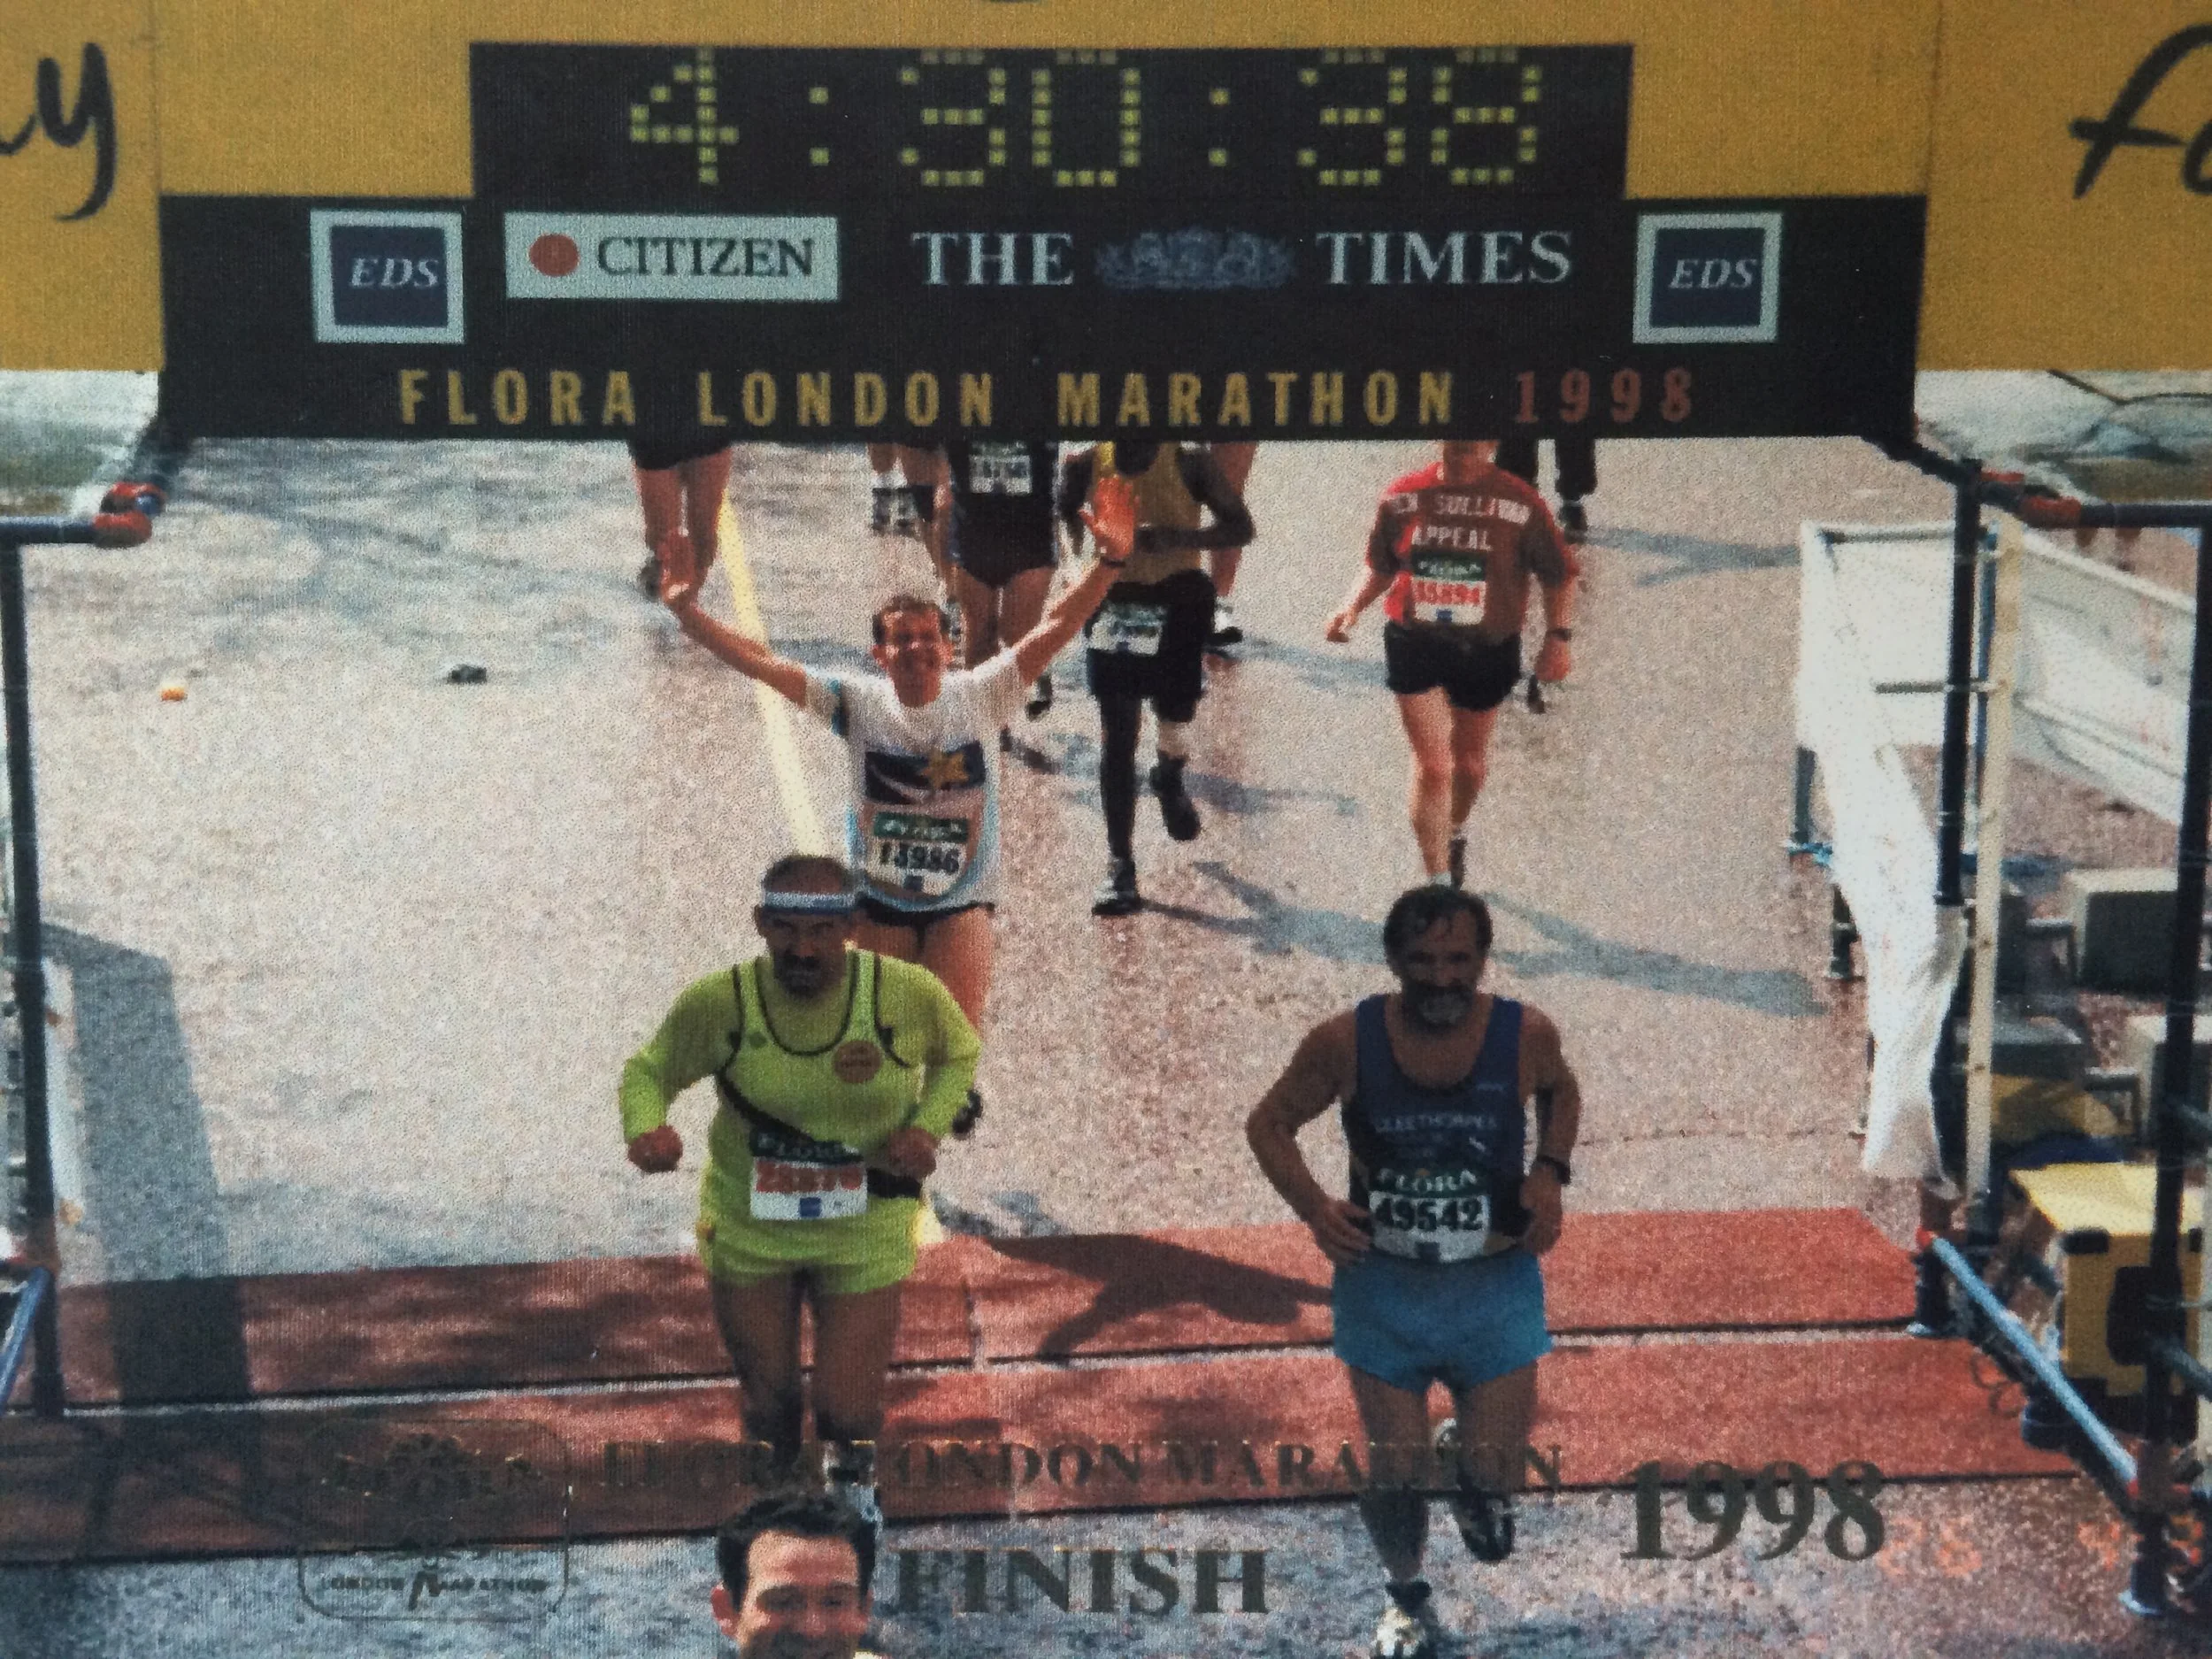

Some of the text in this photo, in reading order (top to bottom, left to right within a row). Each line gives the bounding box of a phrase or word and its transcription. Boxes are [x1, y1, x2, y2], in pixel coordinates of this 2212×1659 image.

[350, 257, 439, 288] EDS
[596, 236, 814, 278] CITIZEN
[911, 231, 1571, 286] THE TIMES
[1669, 258, 1755, 290] EDS
[399, 368, 1692, 426] FLORA LONDON MARATHON 1998
[1376, 1196, 1485, 1233] 49542
